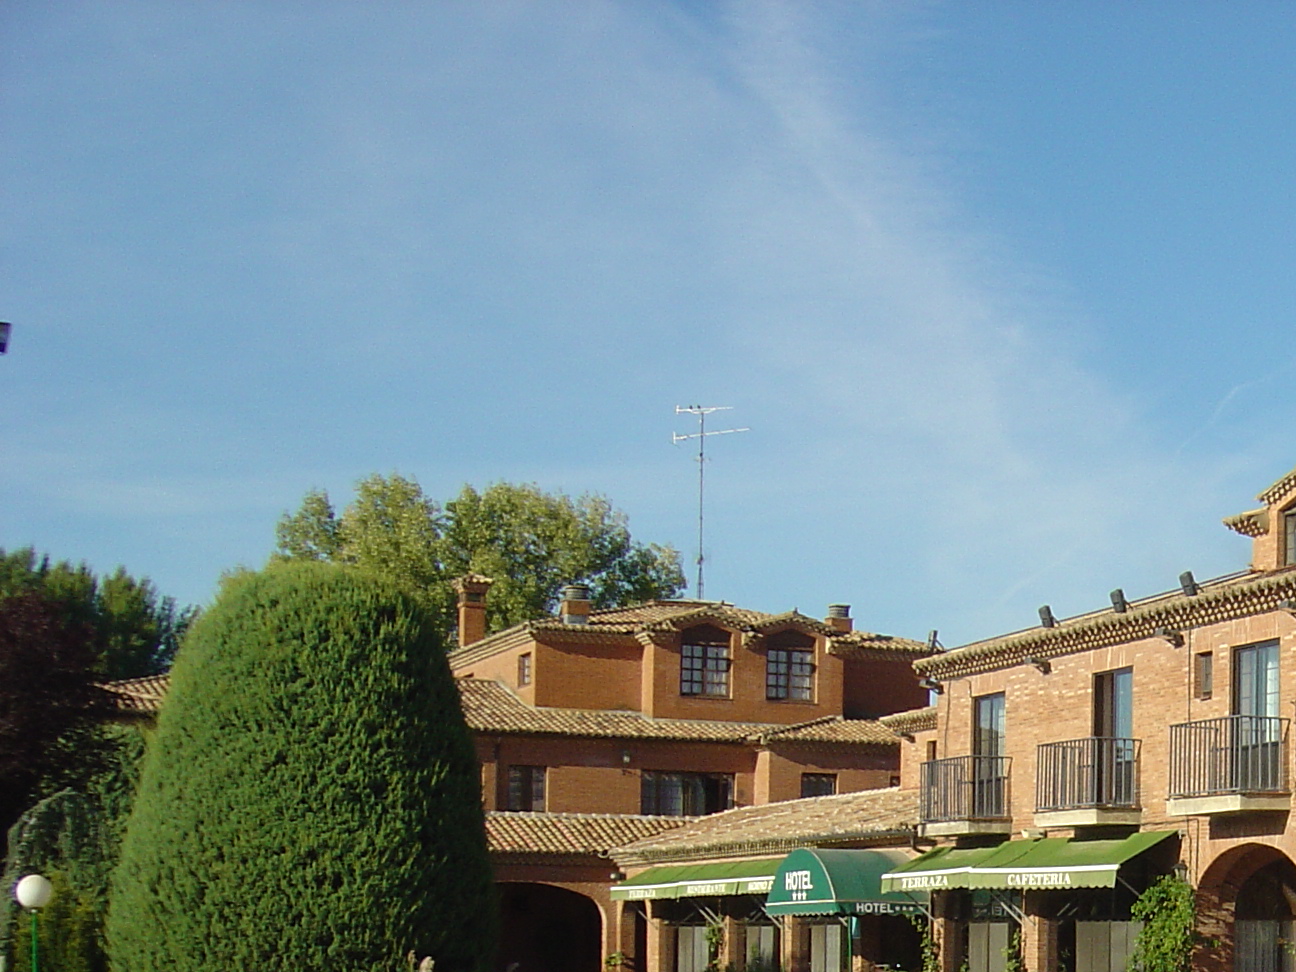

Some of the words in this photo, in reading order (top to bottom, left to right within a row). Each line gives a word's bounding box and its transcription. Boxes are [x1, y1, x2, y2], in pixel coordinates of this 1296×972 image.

[785, 870, 813, 890] HOTEL
[902, 875, 948, 889] TERRAZA
[856, 902, 894, 914] HOTEL
